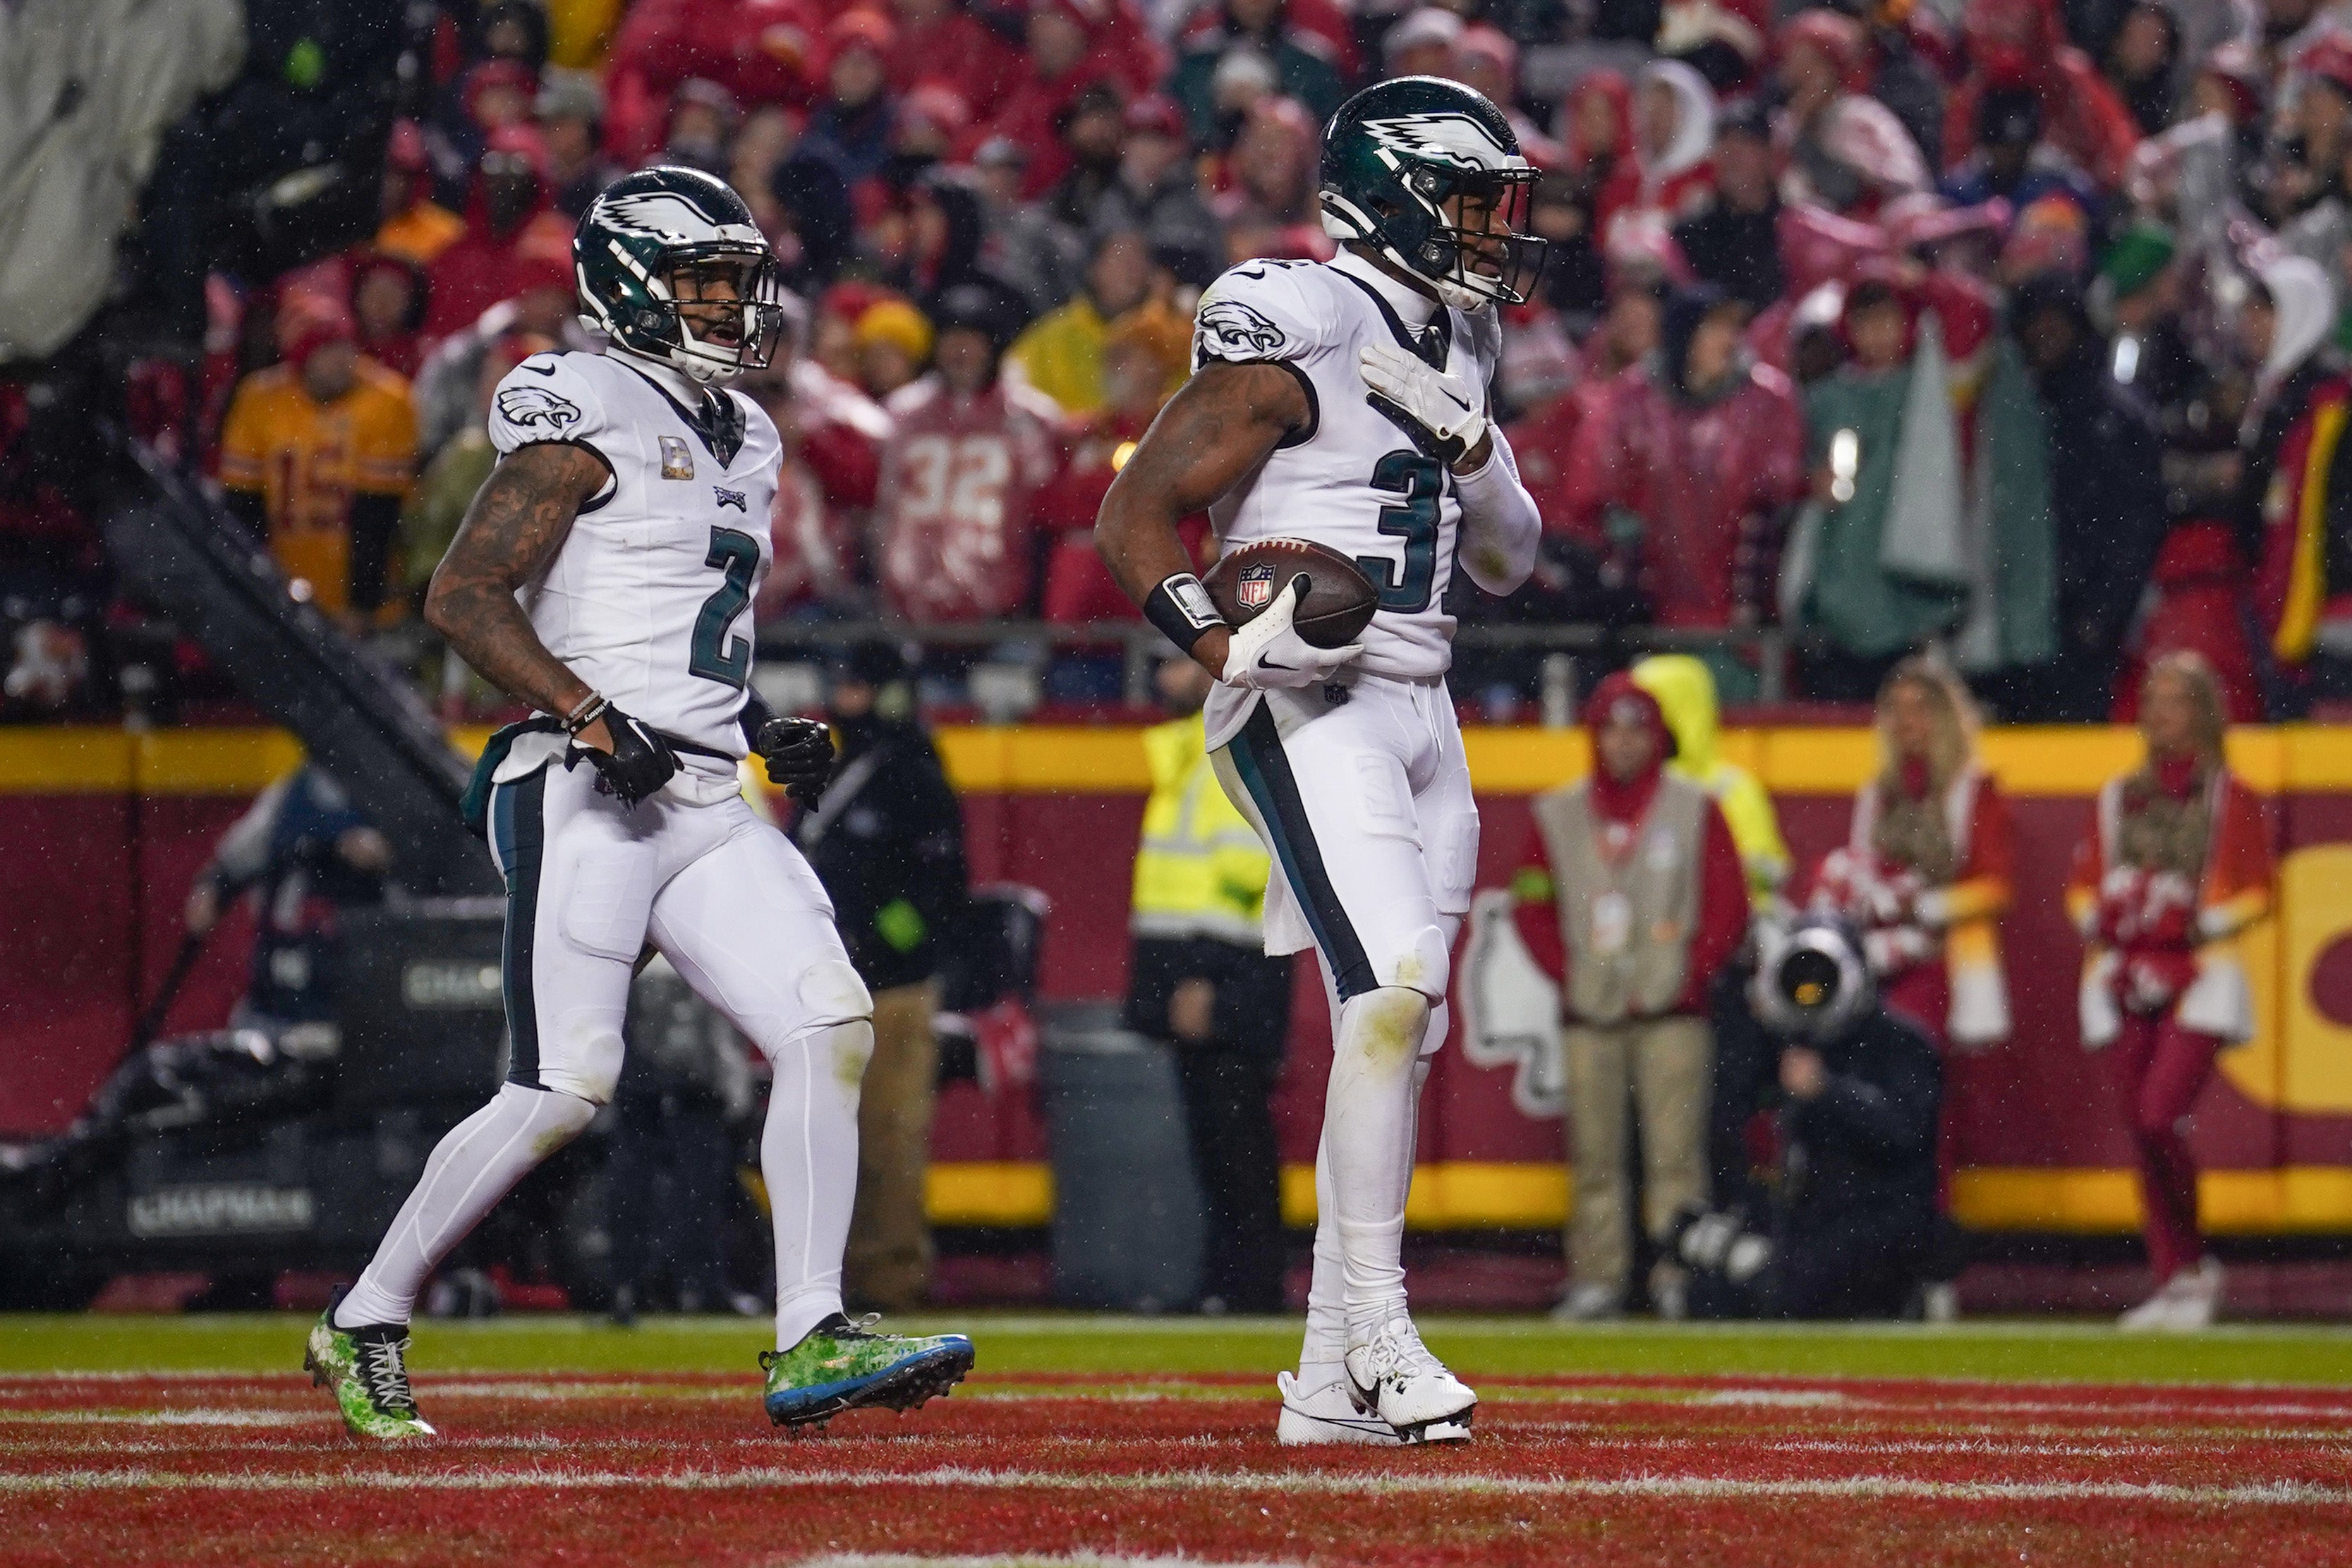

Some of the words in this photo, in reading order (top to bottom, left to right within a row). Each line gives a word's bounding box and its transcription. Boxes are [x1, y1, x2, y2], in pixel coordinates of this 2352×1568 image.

[901, 430, 1011, 521] 32
[1356, 449, 1455, 614] 3
[689, 525, 759, 692] 2
[1240, 581, 1268, 604] NFL
